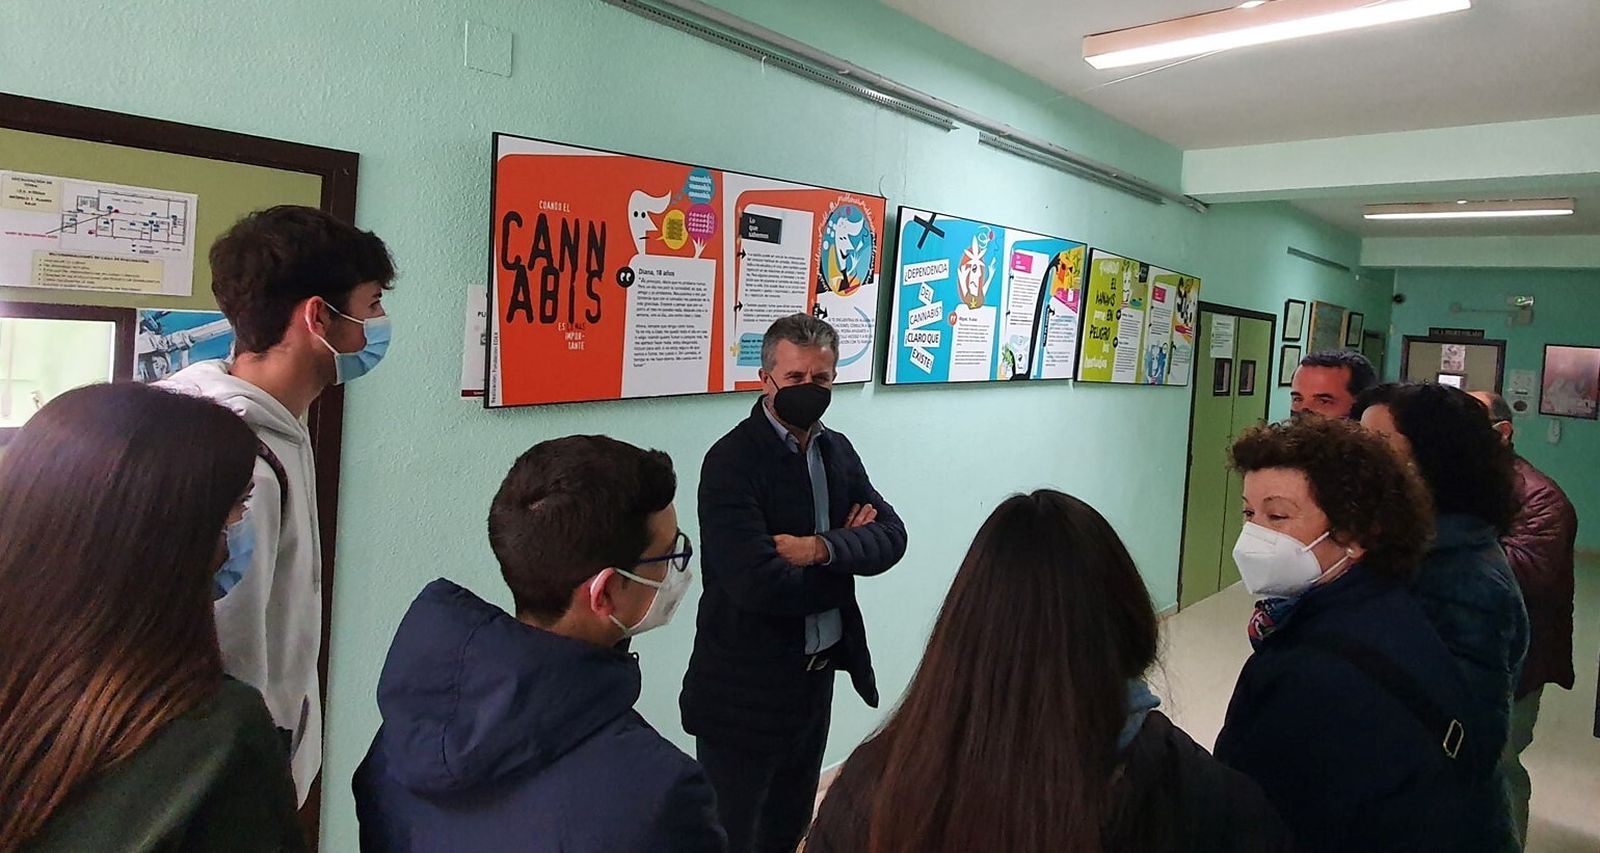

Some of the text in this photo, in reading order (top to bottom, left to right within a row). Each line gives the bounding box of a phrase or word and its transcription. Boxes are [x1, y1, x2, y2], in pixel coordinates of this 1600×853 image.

[538, 200, 570, 212] CUANDO EL
[501, 211, 606, 272] CANN
[506, 264, 602, 324] ABIS
[920, 286, 931, 302] DEL
[910, 306, 942, 325] CANNABIS?
[558, 322, 566, 331] ES
[1089, 324, 1110, 341] PELIGRO
[565, 332, 585, 341] IMPOR-
[927, 333, 939, 343] QUE
[568, 341, 585, 350] TANTE
[911, 348, 932, 369] EXISTE!
